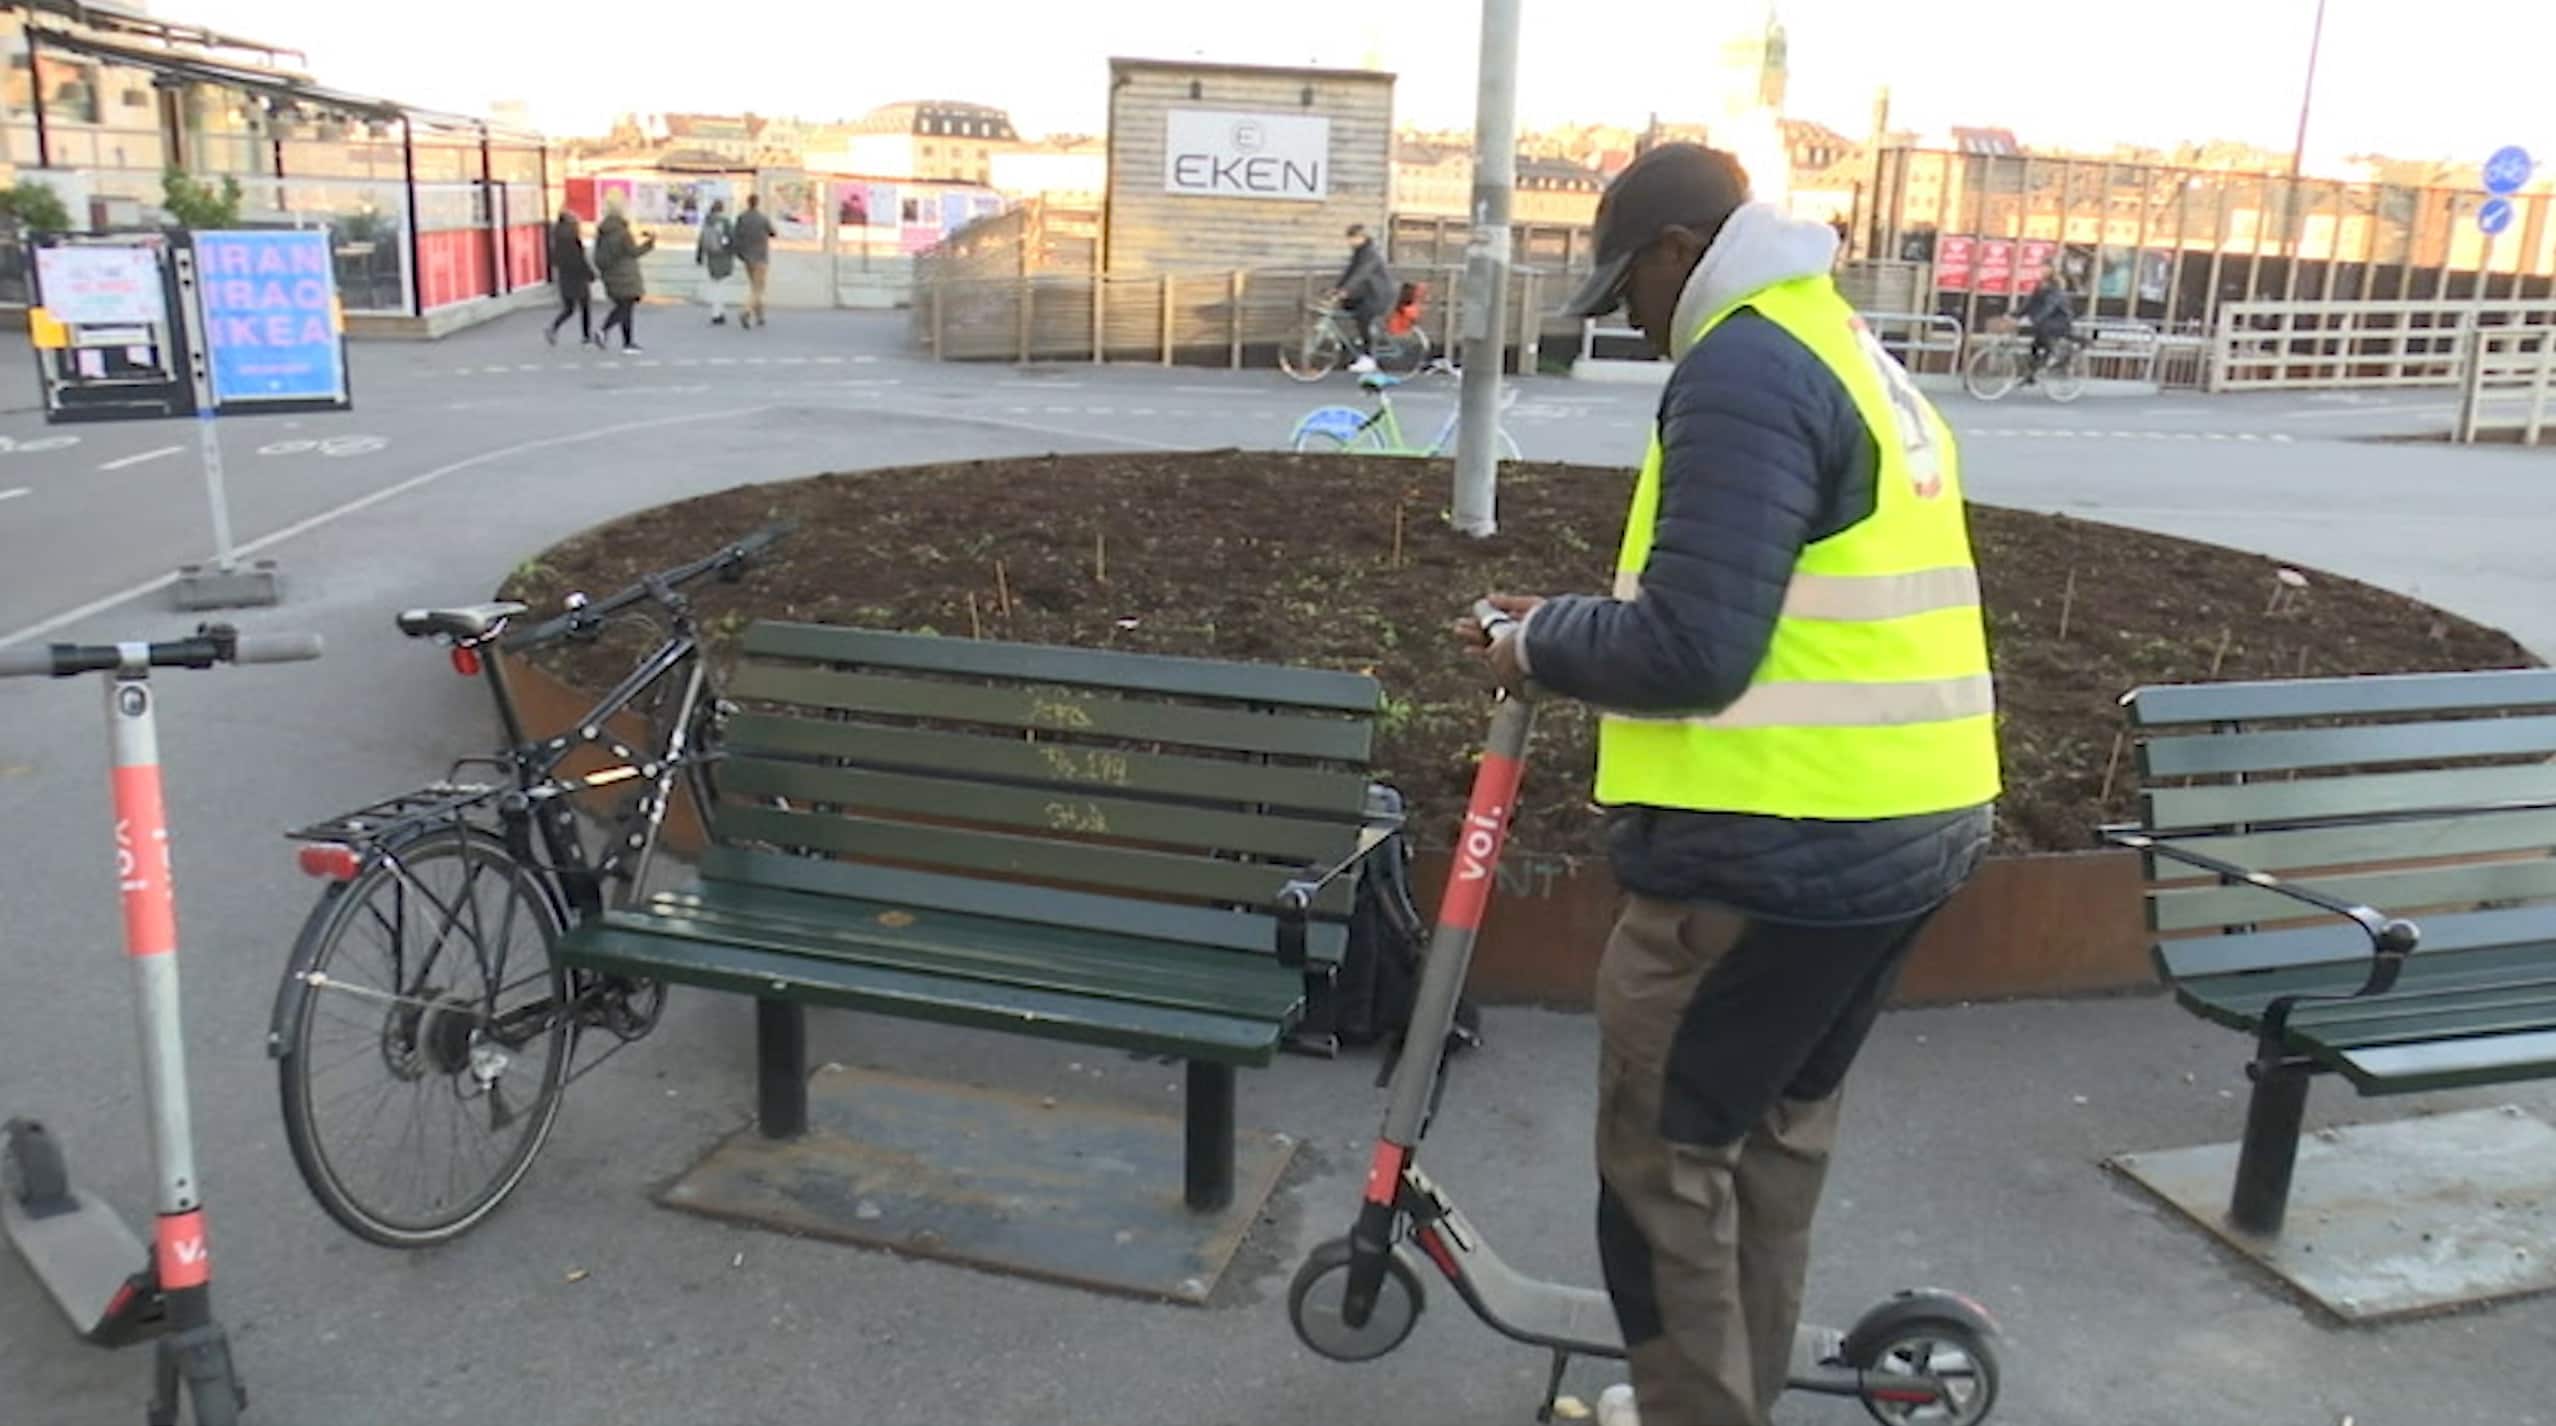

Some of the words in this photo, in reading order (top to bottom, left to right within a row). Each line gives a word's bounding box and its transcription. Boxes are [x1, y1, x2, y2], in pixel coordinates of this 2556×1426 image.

[1174, 153, 1318, 192] EKEN
[200, 243, 323, 274] IRAN
[206, 314, 332, 347] IKEA
[1458, 805, 1502, 880] voi.
